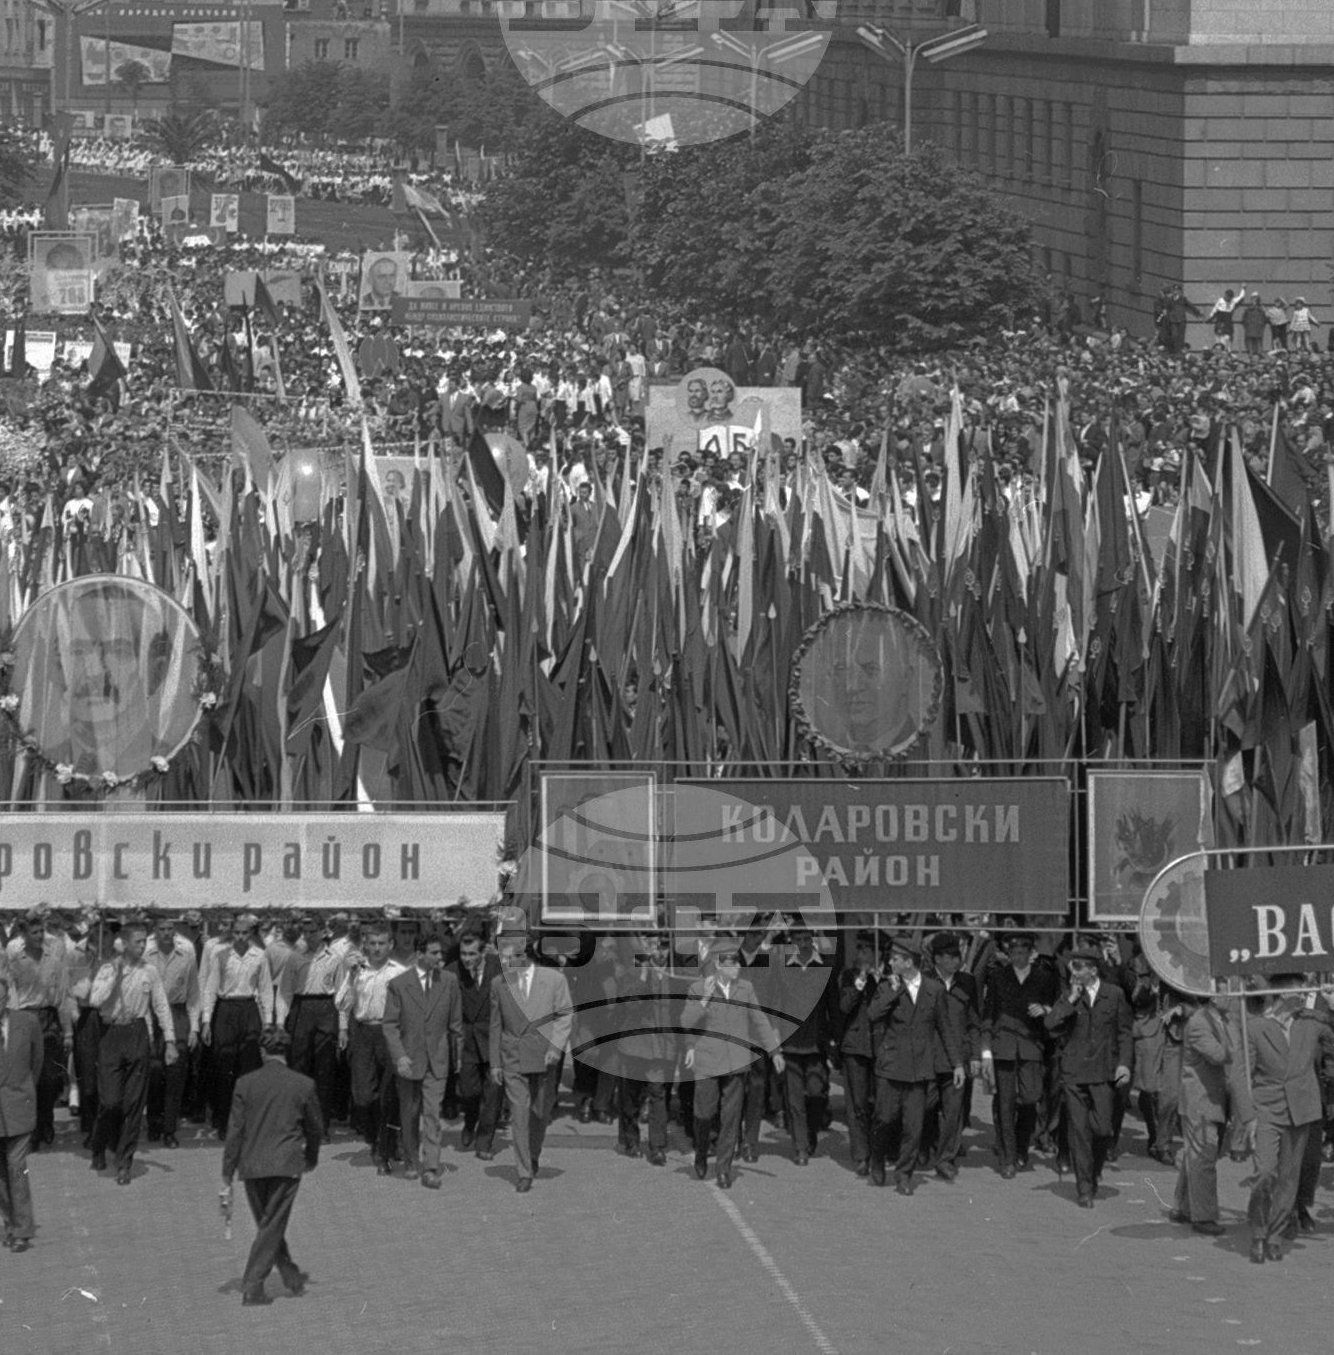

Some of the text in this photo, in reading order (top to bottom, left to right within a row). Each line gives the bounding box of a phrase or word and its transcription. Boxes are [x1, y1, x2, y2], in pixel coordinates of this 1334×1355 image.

[182, 8, 253, 17] РЕПУБЛИ
[721, 804, 1020, 844] КОЛАРОВСКИ
[242, 835, 420, 893] район
[795, 848, 940, 887] РАЙОН
